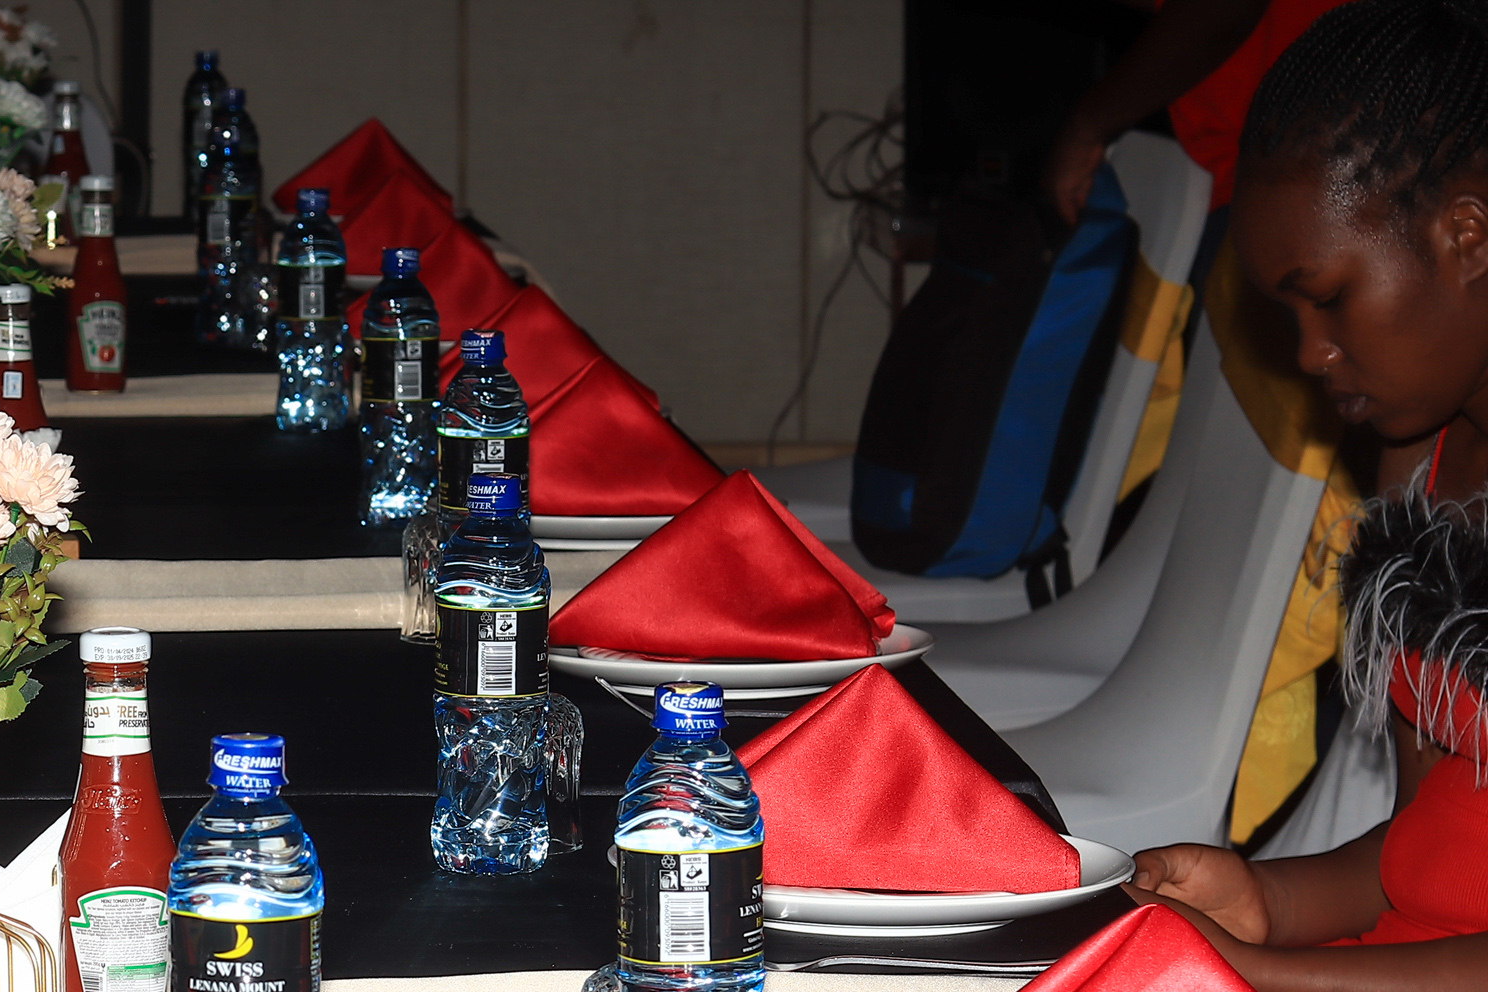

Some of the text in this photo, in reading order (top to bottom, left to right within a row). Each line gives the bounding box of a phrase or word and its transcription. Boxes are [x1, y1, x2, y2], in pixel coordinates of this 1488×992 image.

[468, 484, 507, 494] ESHMAX
[675, 718, 718, 729] WATER
[226, 774, 272, 788] WATER
[206, 961, 264, 977] SWISS
